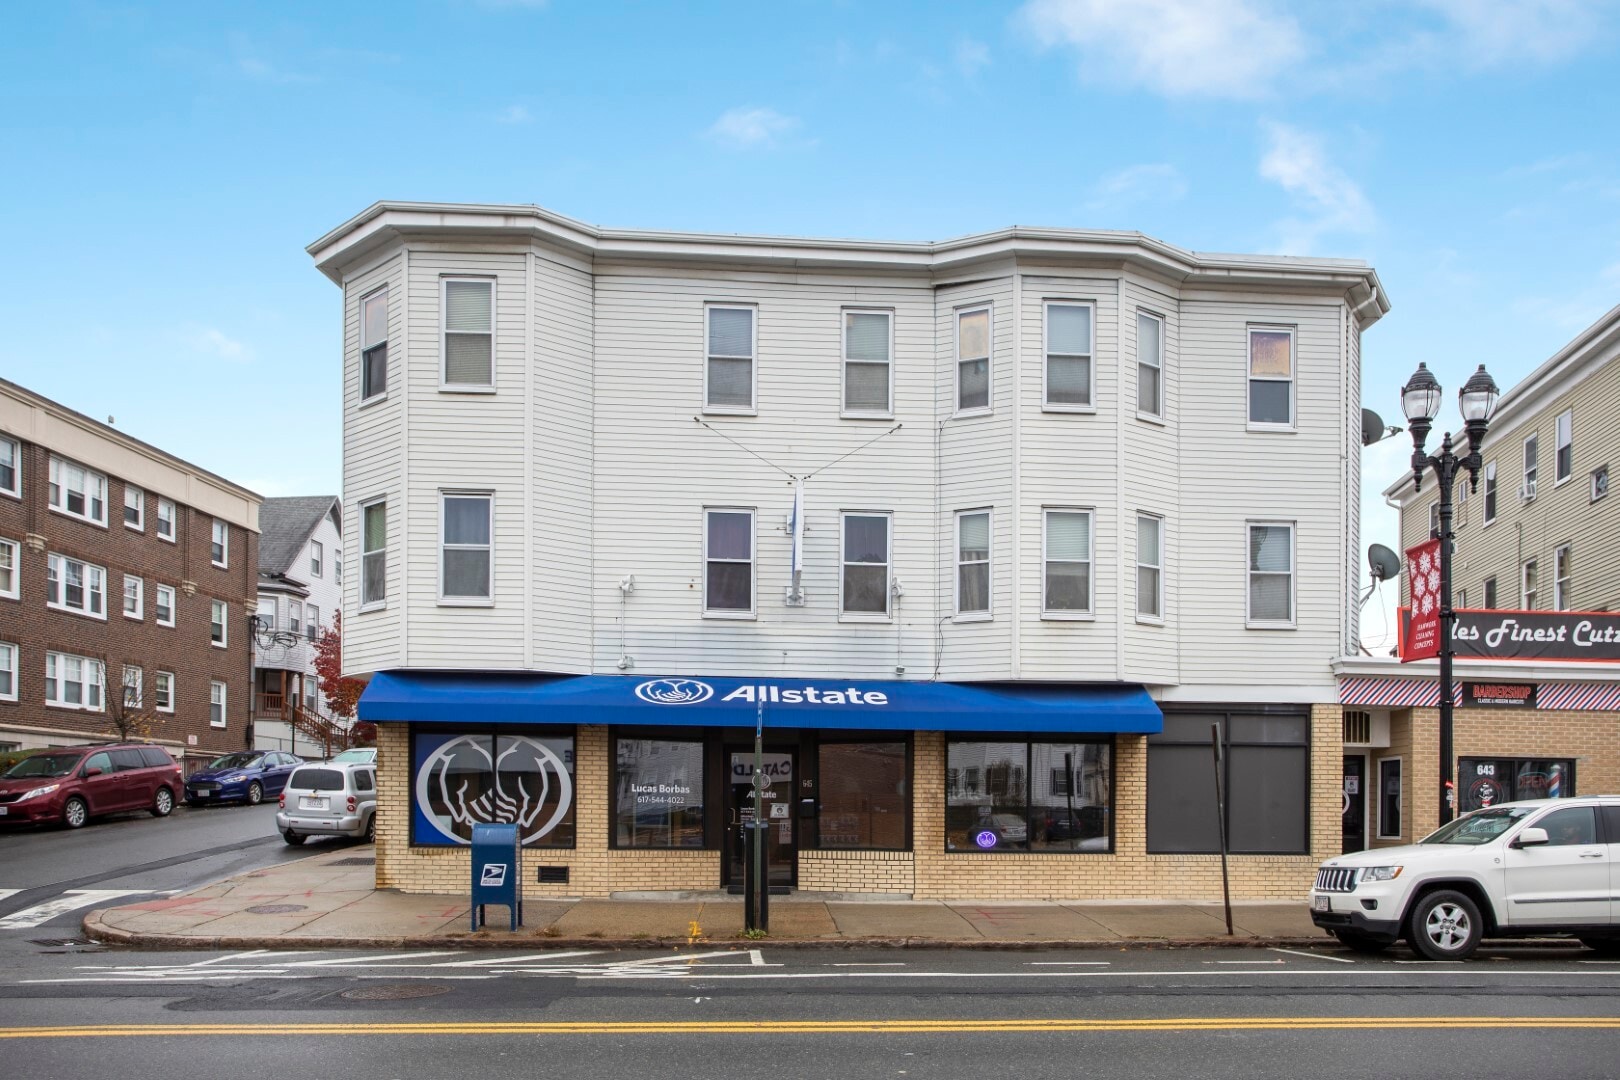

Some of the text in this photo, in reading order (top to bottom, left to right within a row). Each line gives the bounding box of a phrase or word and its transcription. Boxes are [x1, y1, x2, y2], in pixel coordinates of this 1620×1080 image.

[1485, 619, 1568, 648] Finest
[721, 685, 889, 705] Allstate
[1473, 684, 1532, 699] BARBERSHOP
[1476, 764, 1495, 776] 643
[631, 783, 690, 794] Lucas Borbas
[637, 795, 685, 804] 617-544-4022
